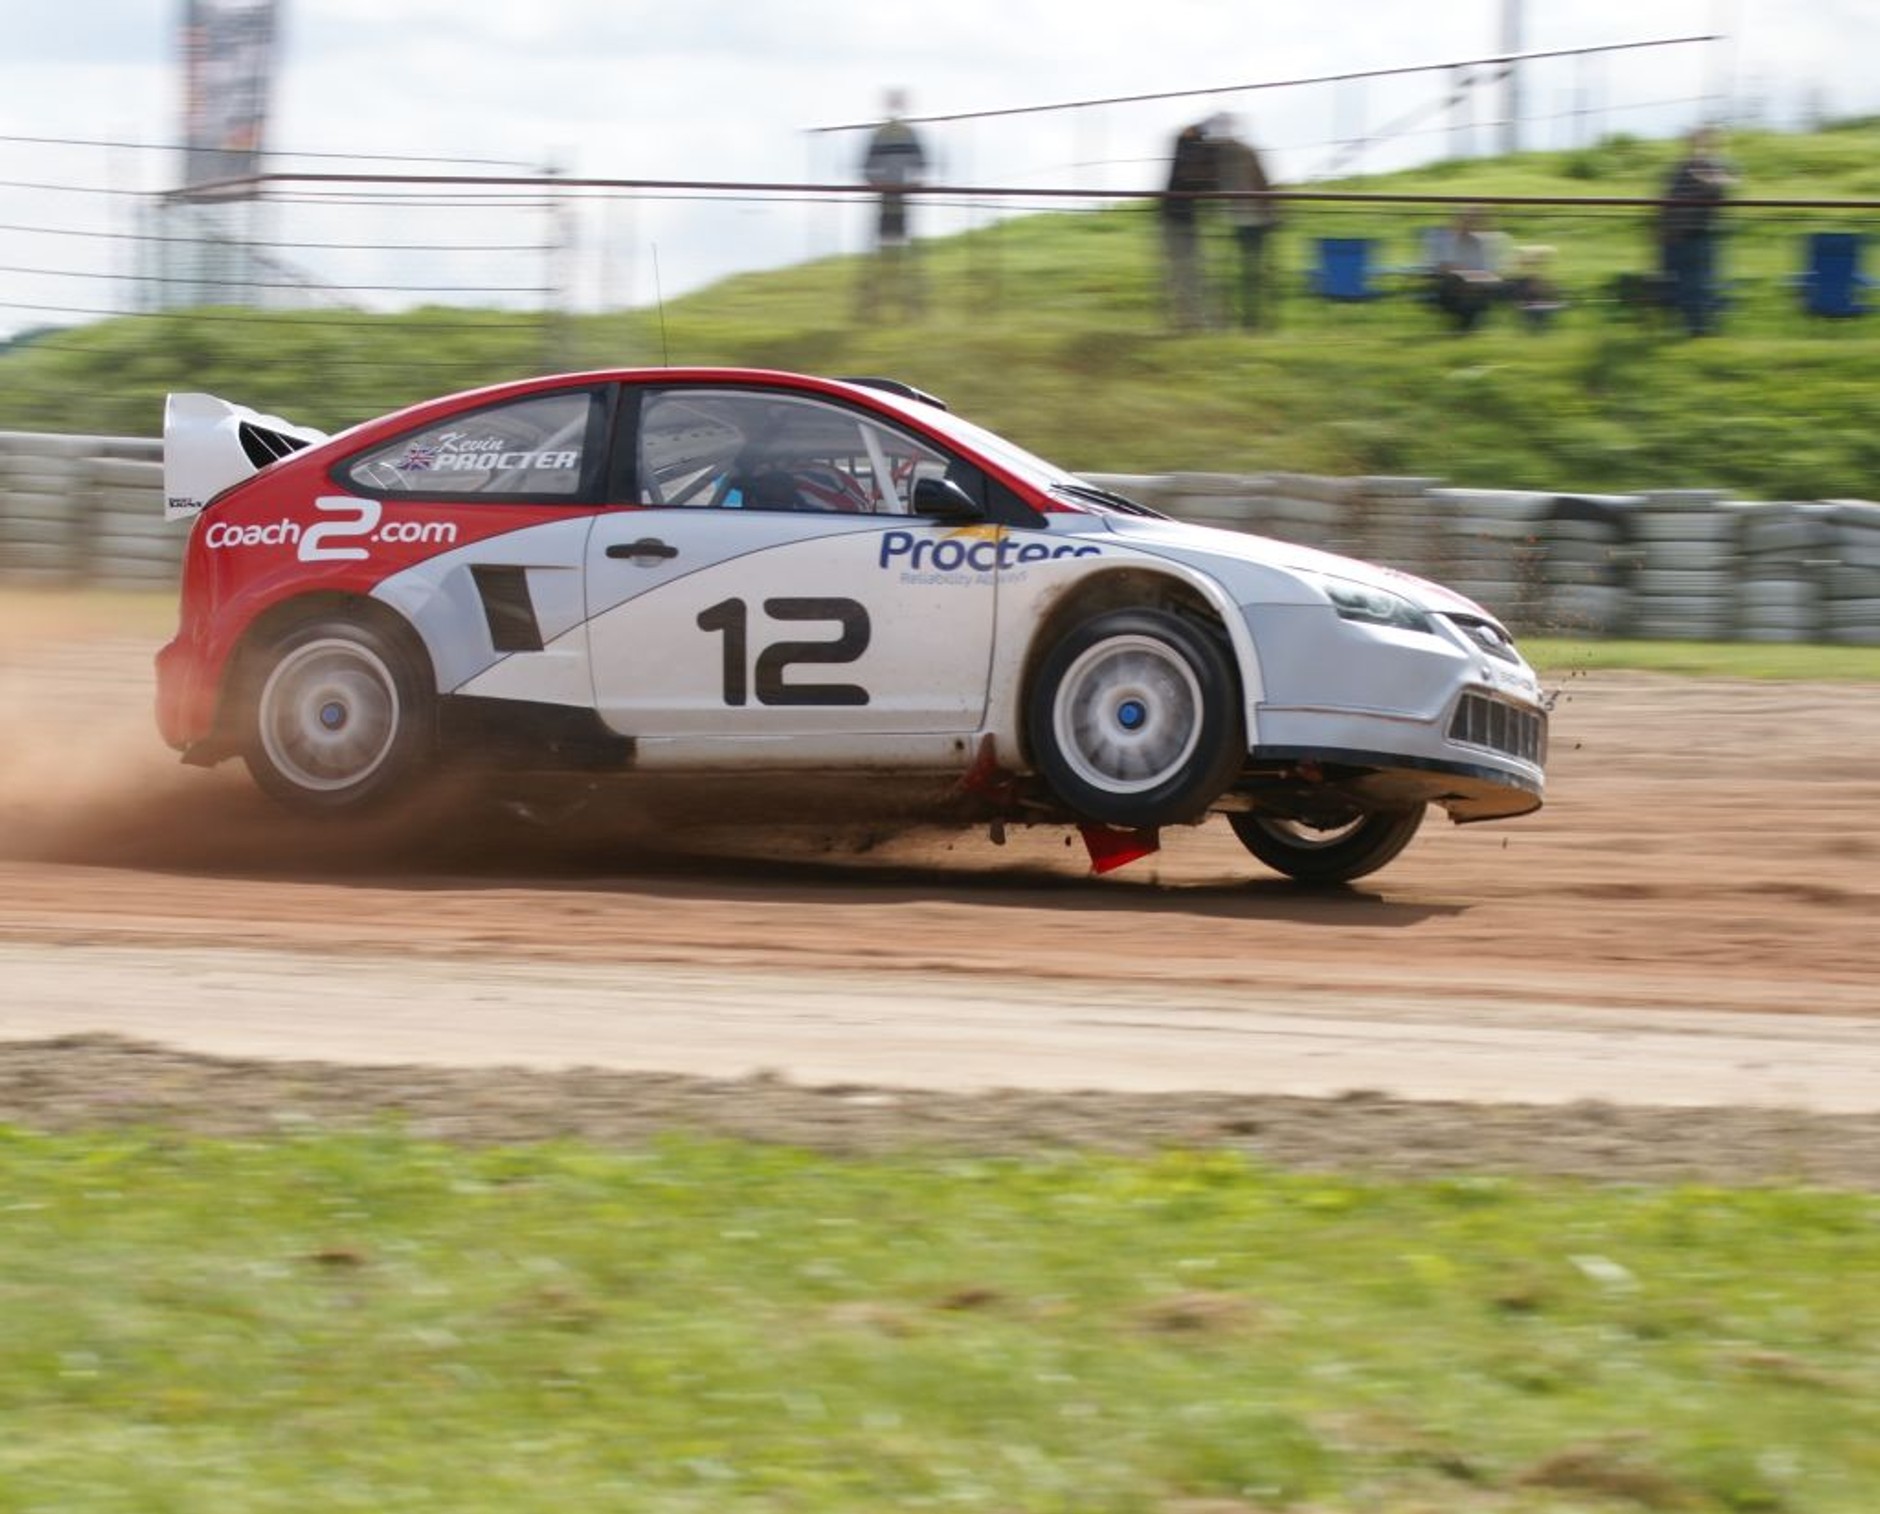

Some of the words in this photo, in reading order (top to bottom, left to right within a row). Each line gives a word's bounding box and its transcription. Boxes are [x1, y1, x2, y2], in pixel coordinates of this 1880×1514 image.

[432, 451, 578, 471] PROCTER
[438, 432, 505, 452] Kevin
[205, 496, 457, 562] Coach2.com
[697, 597, 871, 706] 12
